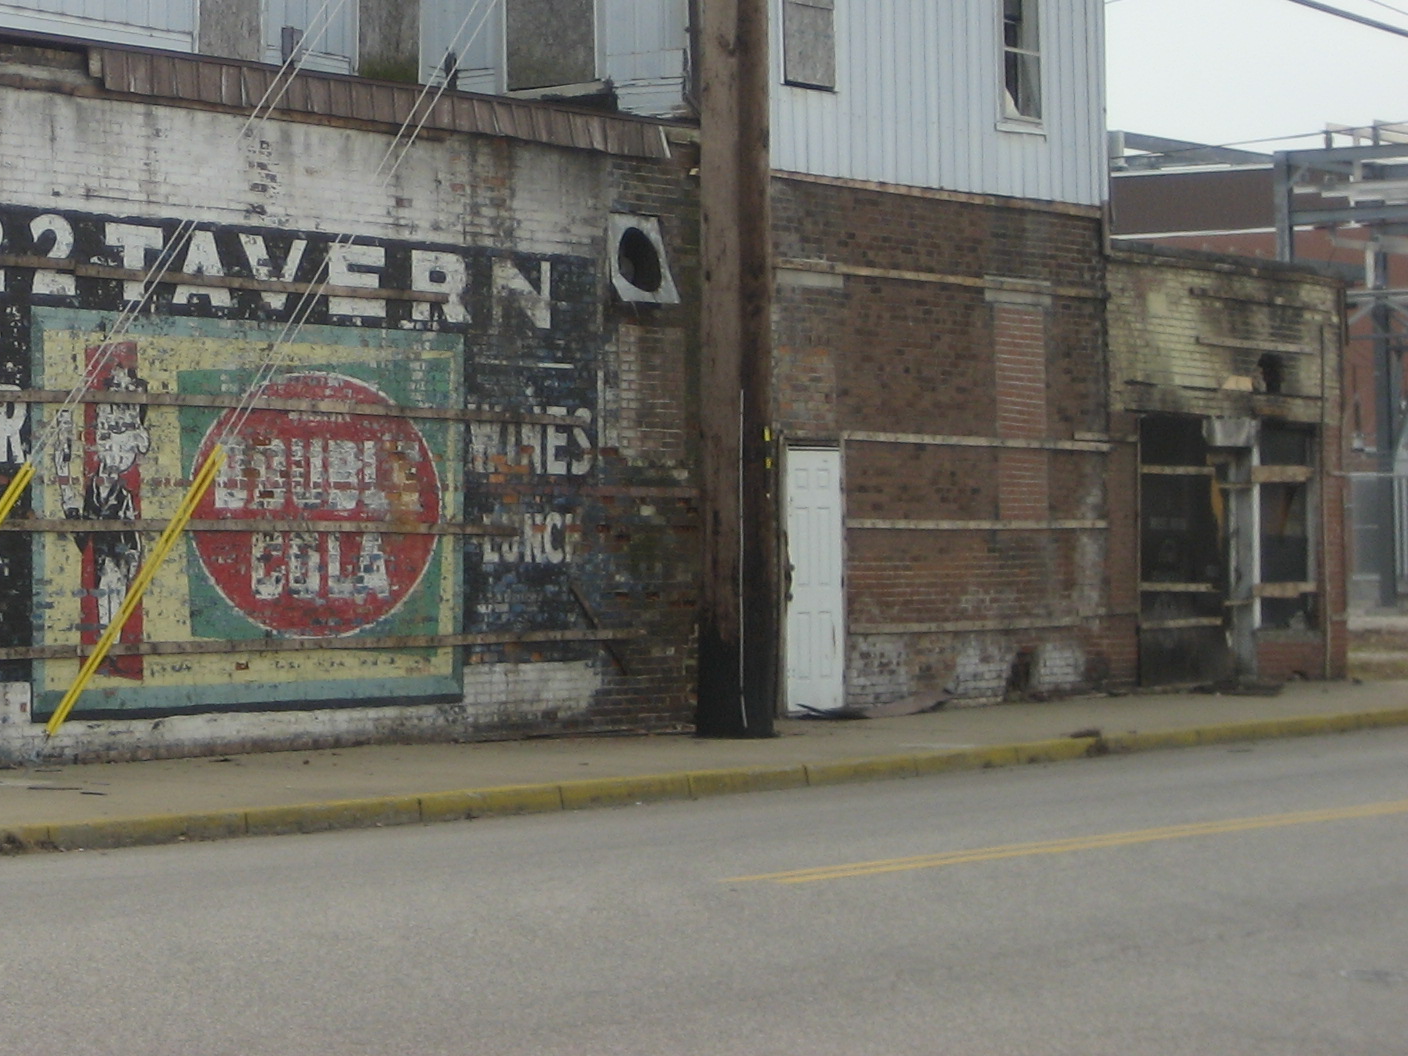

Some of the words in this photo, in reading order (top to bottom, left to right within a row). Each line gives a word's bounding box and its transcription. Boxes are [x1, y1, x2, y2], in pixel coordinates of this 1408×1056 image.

[105, 221, 552, 329] TAVERN
[467, 403, 592, 475] WINES
[251, 530, 390, 600] COLA
